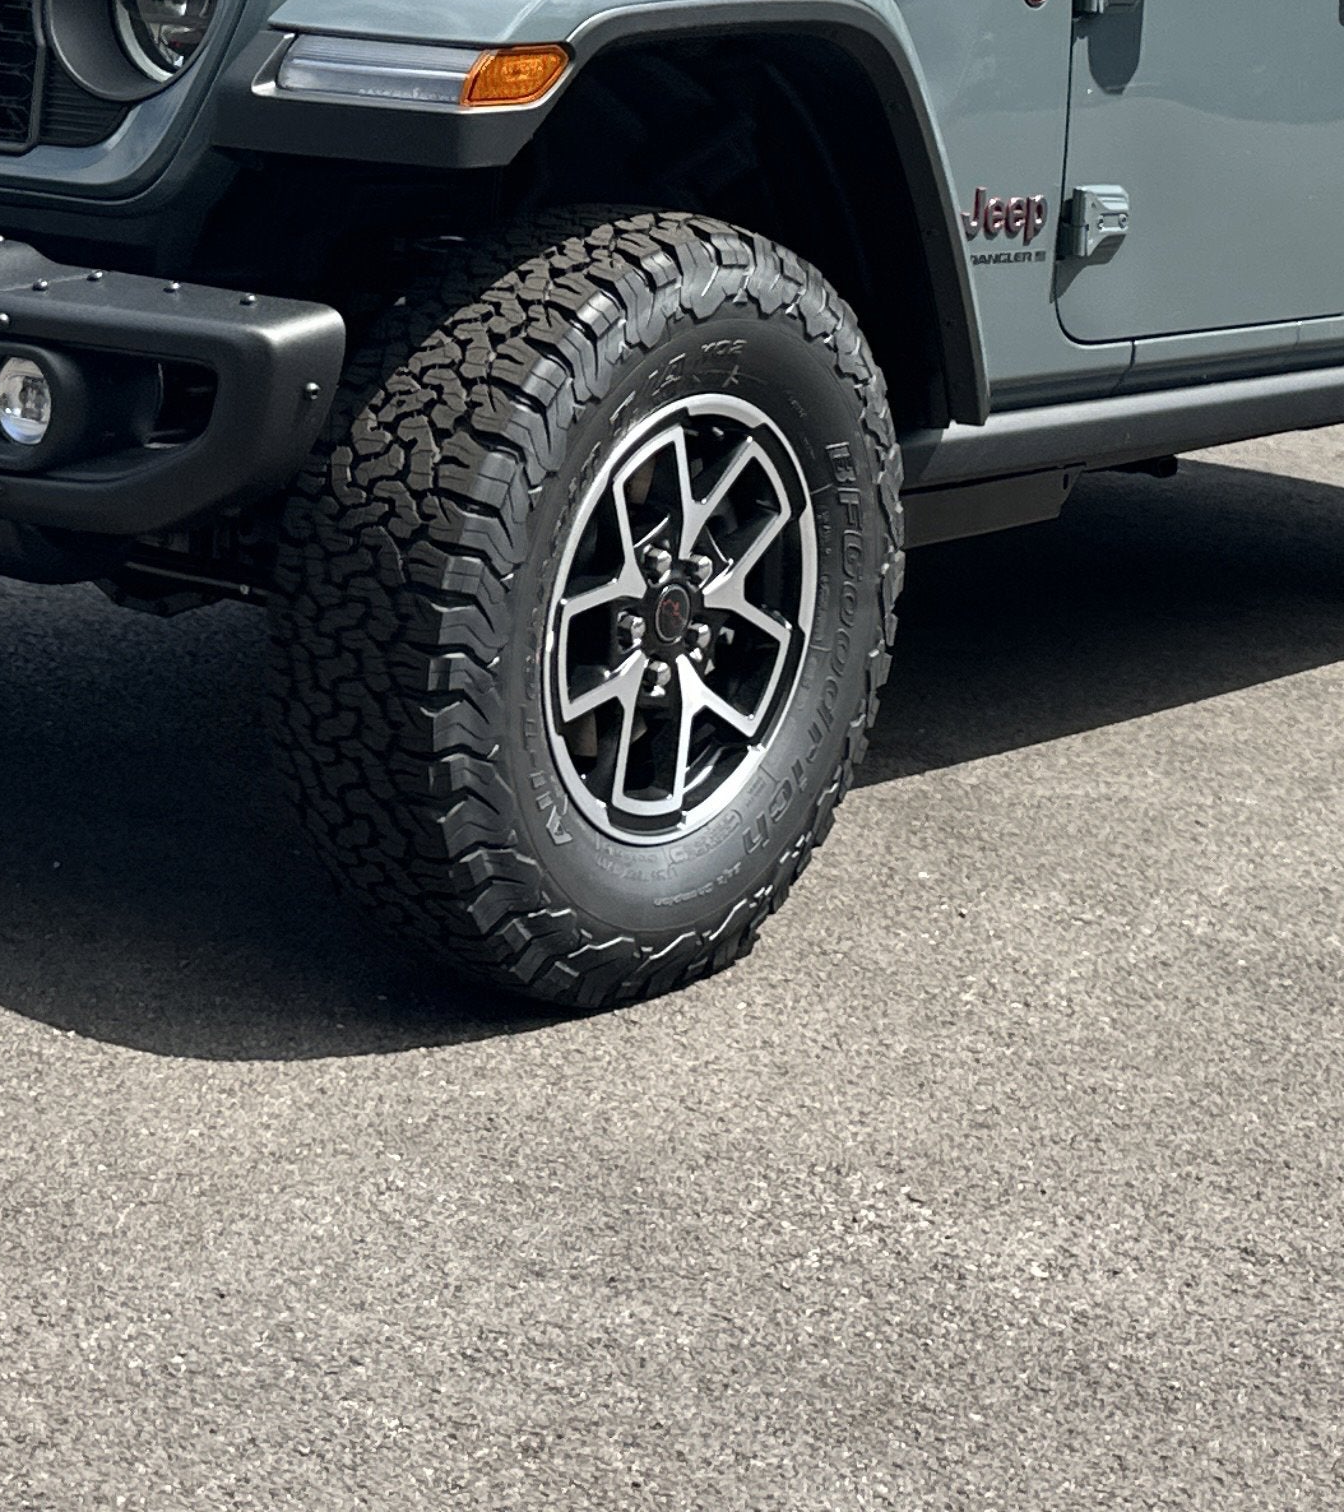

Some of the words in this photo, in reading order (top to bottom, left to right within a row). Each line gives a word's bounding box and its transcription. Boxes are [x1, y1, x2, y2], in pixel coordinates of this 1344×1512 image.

[960, 186, 1048, 246] Jeep
[969, 253, 1033, 266] RANGLER
[741, 441, 862, 856] BFGoodrich
